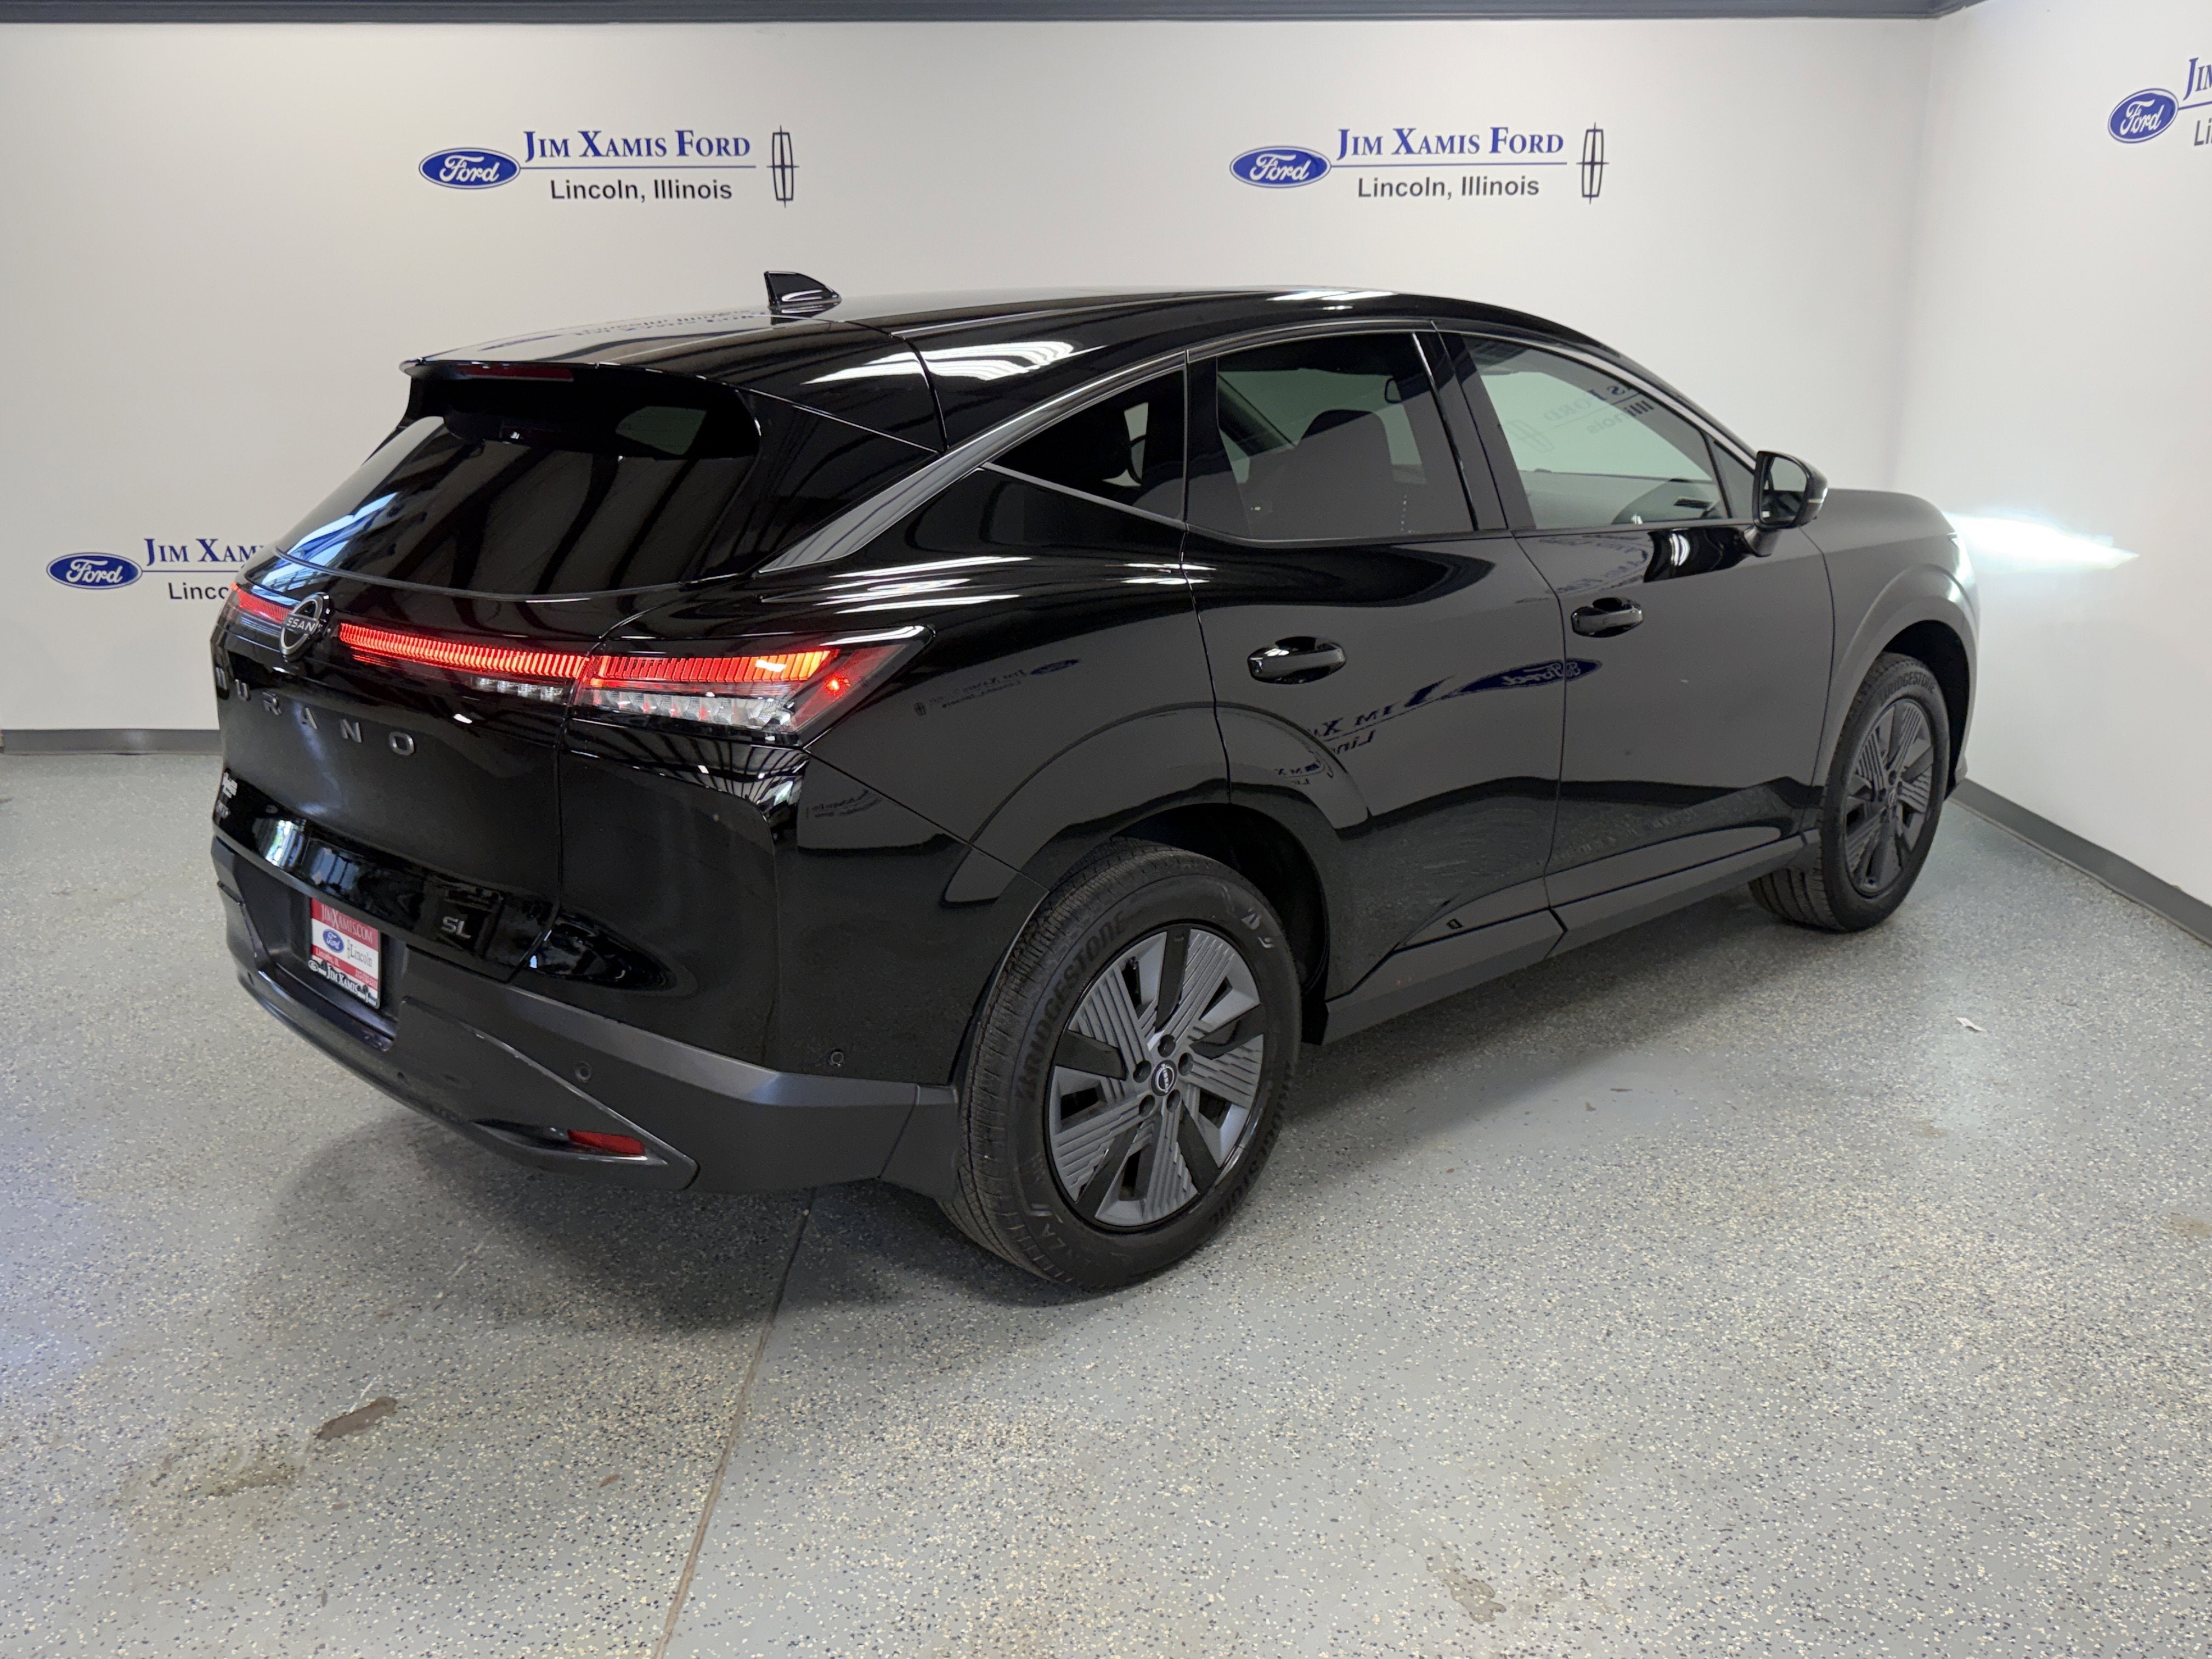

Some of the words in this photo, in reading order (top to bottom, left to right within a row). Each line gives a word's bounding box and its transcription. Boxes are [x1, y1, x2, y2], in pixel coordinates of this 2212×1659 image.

[2120, 99, 2165, 135] Ford
[523, 131, 570, 163] JIM
[578, 130, 667, 157] XAMIS
[675, 129, 751, 157] FORD
[1336, 128, 1384, 161] JIM
[1391, 127, 1481, 156] XAMIS
[1488, 126, 1564, 154] FORD
[439, 154, 500, 183] Ford
[1249, 153, 1311, 181] Ford
[550, 179, 646, 202] Lincoln,
[654, 179, 732, 200] Illinois
[1358, 177, 1453, 200] Lincoln,
[1461, 176, 1540, 197] Illinois
[144, 538, 190, 566] JIM
[195, 538, 264, 562] XAM
[65, 558, 123, 583] Ford
[168, 582, 229, 600] Linco
[286, 617, 317, 633] SSAN
[441, 916, 472, 939] SL
[326, 932, 341, 950] Ford
[350, 944, 373, 968] Lincoln
